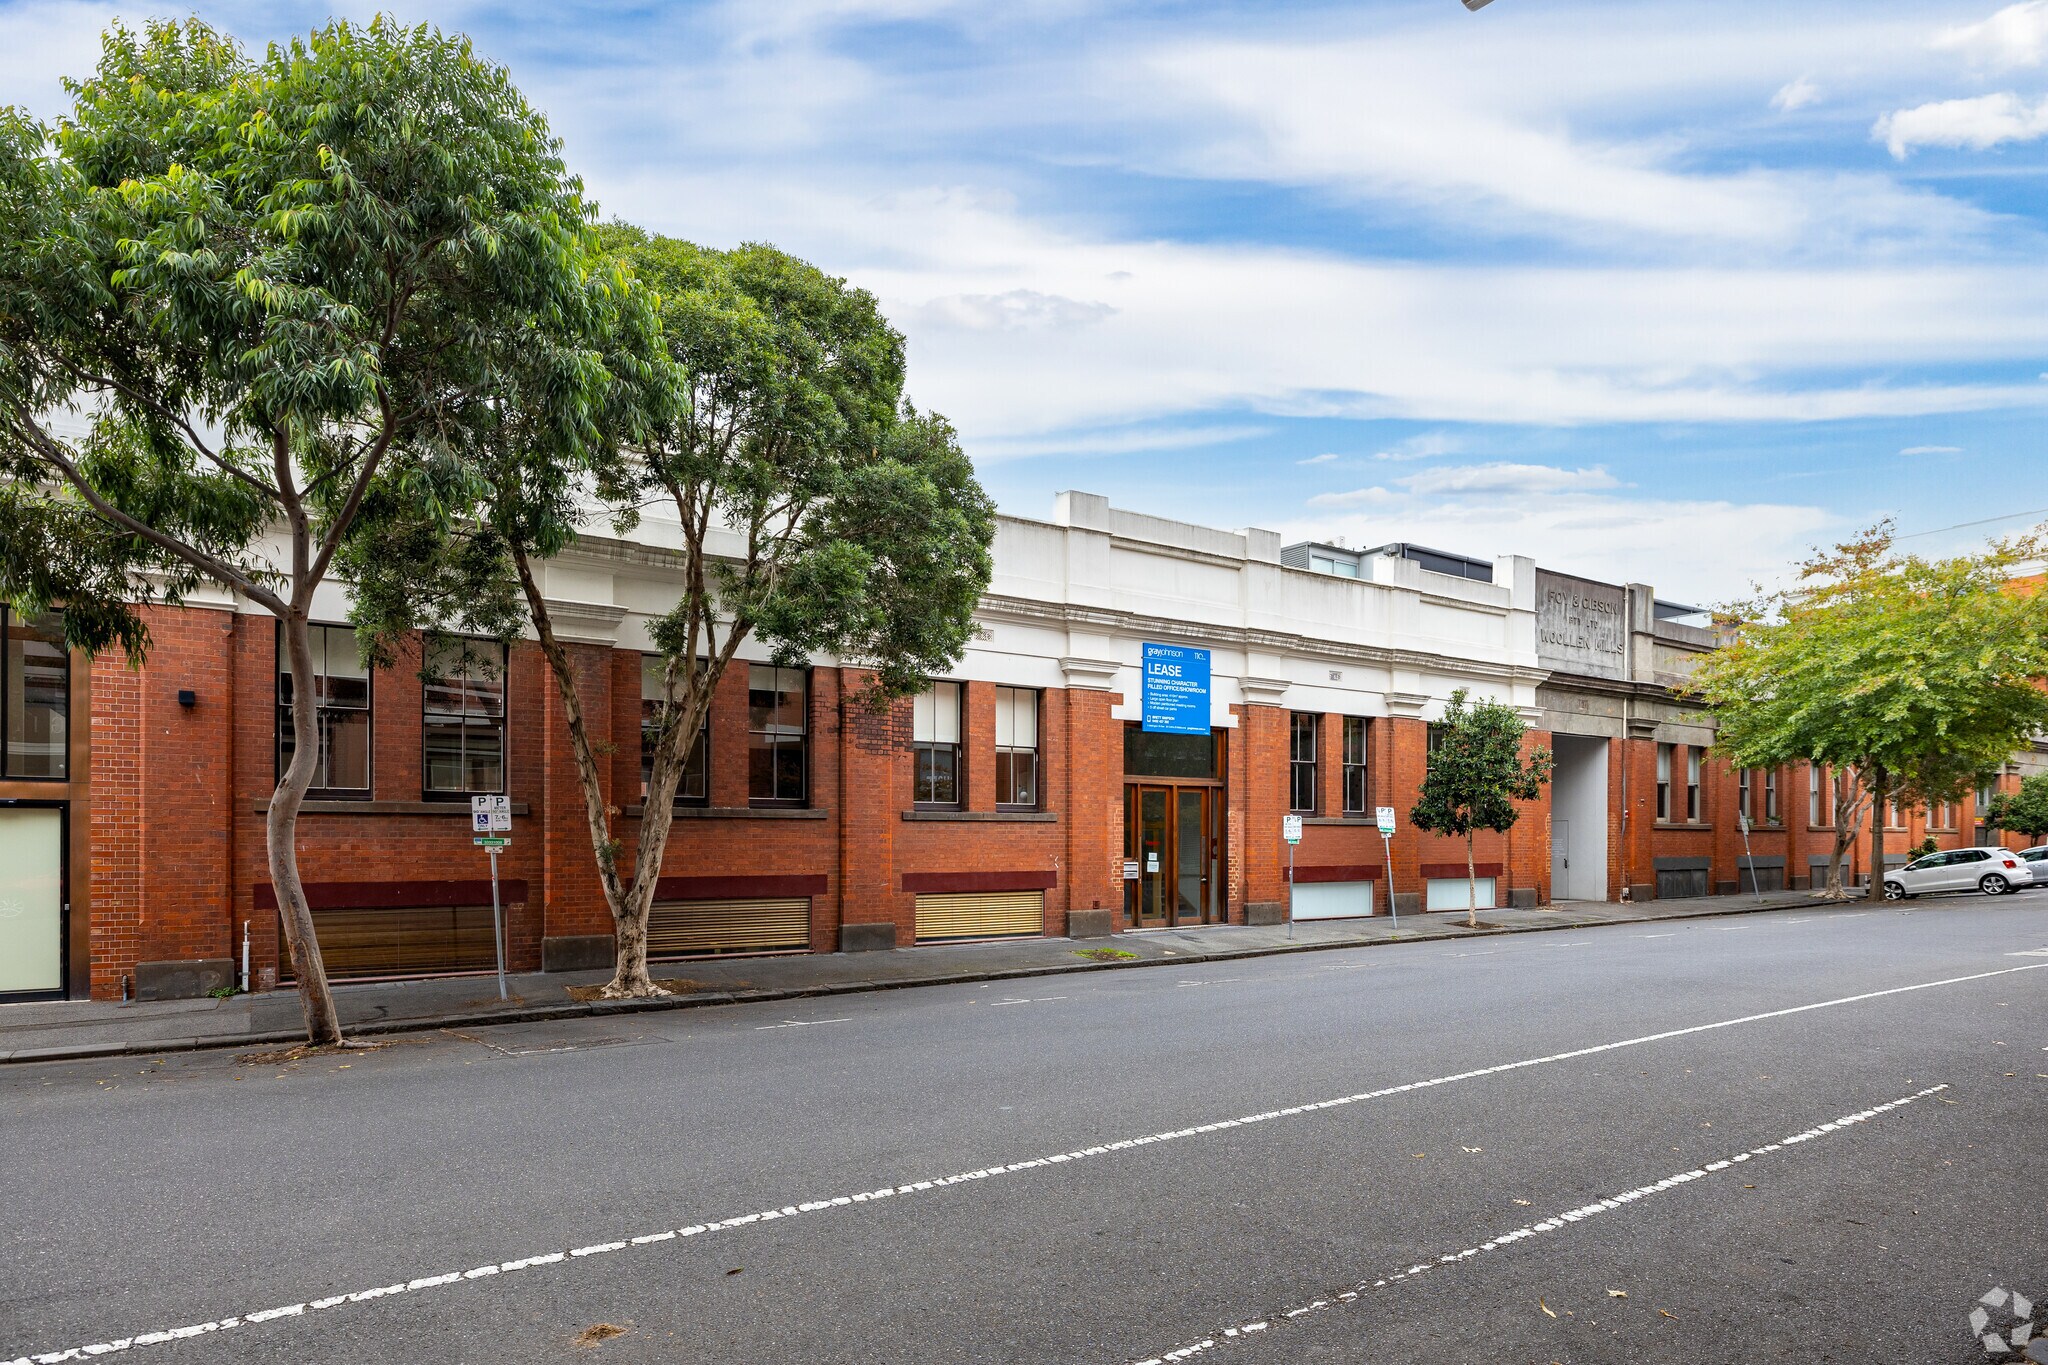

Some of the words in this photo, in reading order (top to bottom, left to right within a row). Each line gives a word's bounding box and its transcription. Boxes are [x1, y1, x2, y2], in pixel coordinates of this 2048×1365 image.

[1548, 591, 1568, 606] FOY
[1572, 594, 1580, 608] &
[1582, 597, 1618, 615] GIBSON
[1540, 628, 1590, 650] WOOLLEN
[1594, 638, 1624, 655] MILLS
[1148, 662, 1182, 677] LEASE
[478, 797, 486, 806] P
[496, 797, 504, 806] P
